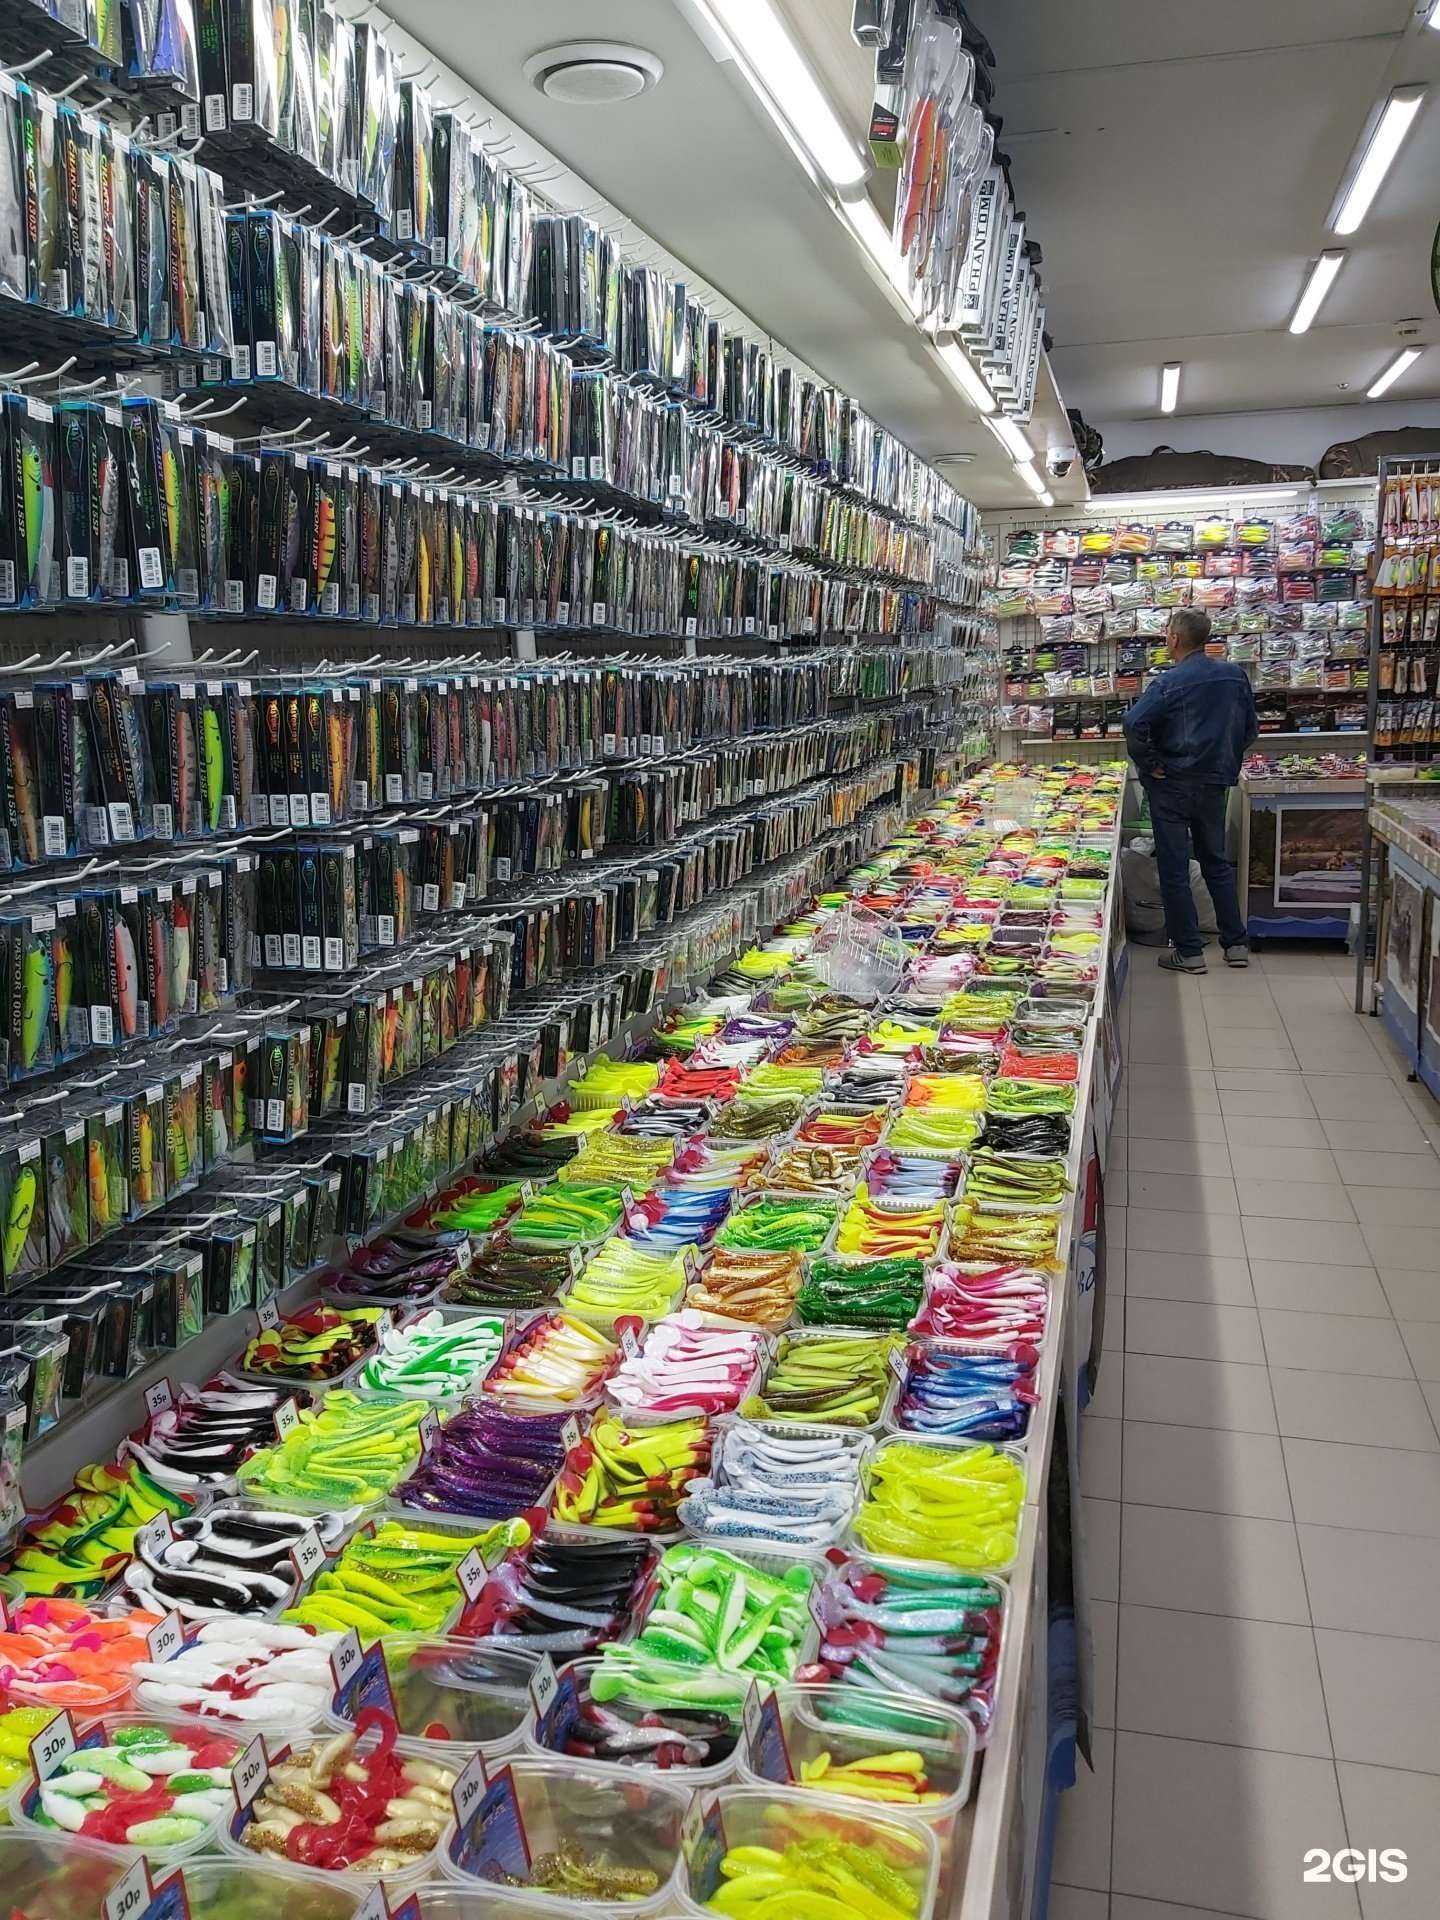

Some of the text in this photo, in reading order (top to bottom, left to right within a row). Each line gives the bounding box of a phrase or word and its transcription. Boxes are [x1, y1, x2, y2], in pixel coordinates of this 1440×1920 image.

[25, 119, 38, 243] CHANCE 130SP
[67, 139, 80, 258] CHANCE 130SP
[101, 154, 110, 221] CHANCE
[170, 183, 179, 291] CHANCE 130SP
[969, 197, 991, 292] PHANTOM
[996, 249, 1016, 335] PHANTOM
[16, 494, 25, 538] 115SP
[91, 494, 99, 536] 115SP
[60, 696, 73, 814] CHANCE 115SP
[112, 685, 136, 799] CHANCE 115SP
[1, 706, 17, 827] CHANCE 115SP
[107, 908, 118, 1004] PASTOR 100SP
[13, 937, 23, 1037] PASTOR 100SP
[131, 1147, 141, 1172] 80F
[166, 1128, 175, 1154] 80F
[152, 1393, 167, 1408] 35р
[281, 1414, 294, 1429] 35р
[154, 1529, 166, 1542] 5р
[302, 1547, 318, 1565] 35р
[466, 1567, 481, 1586] 35р
[156, 1633, 175, 1653] 30р
[339, 1649, 355, 1671] 30р
[42, 1737, 66, 1762] 30р
[241, 1762, 260, 1788] 30р
[461, 1781, 479, 1807] 30р
[116, 1888, 140, 1920] 30р
